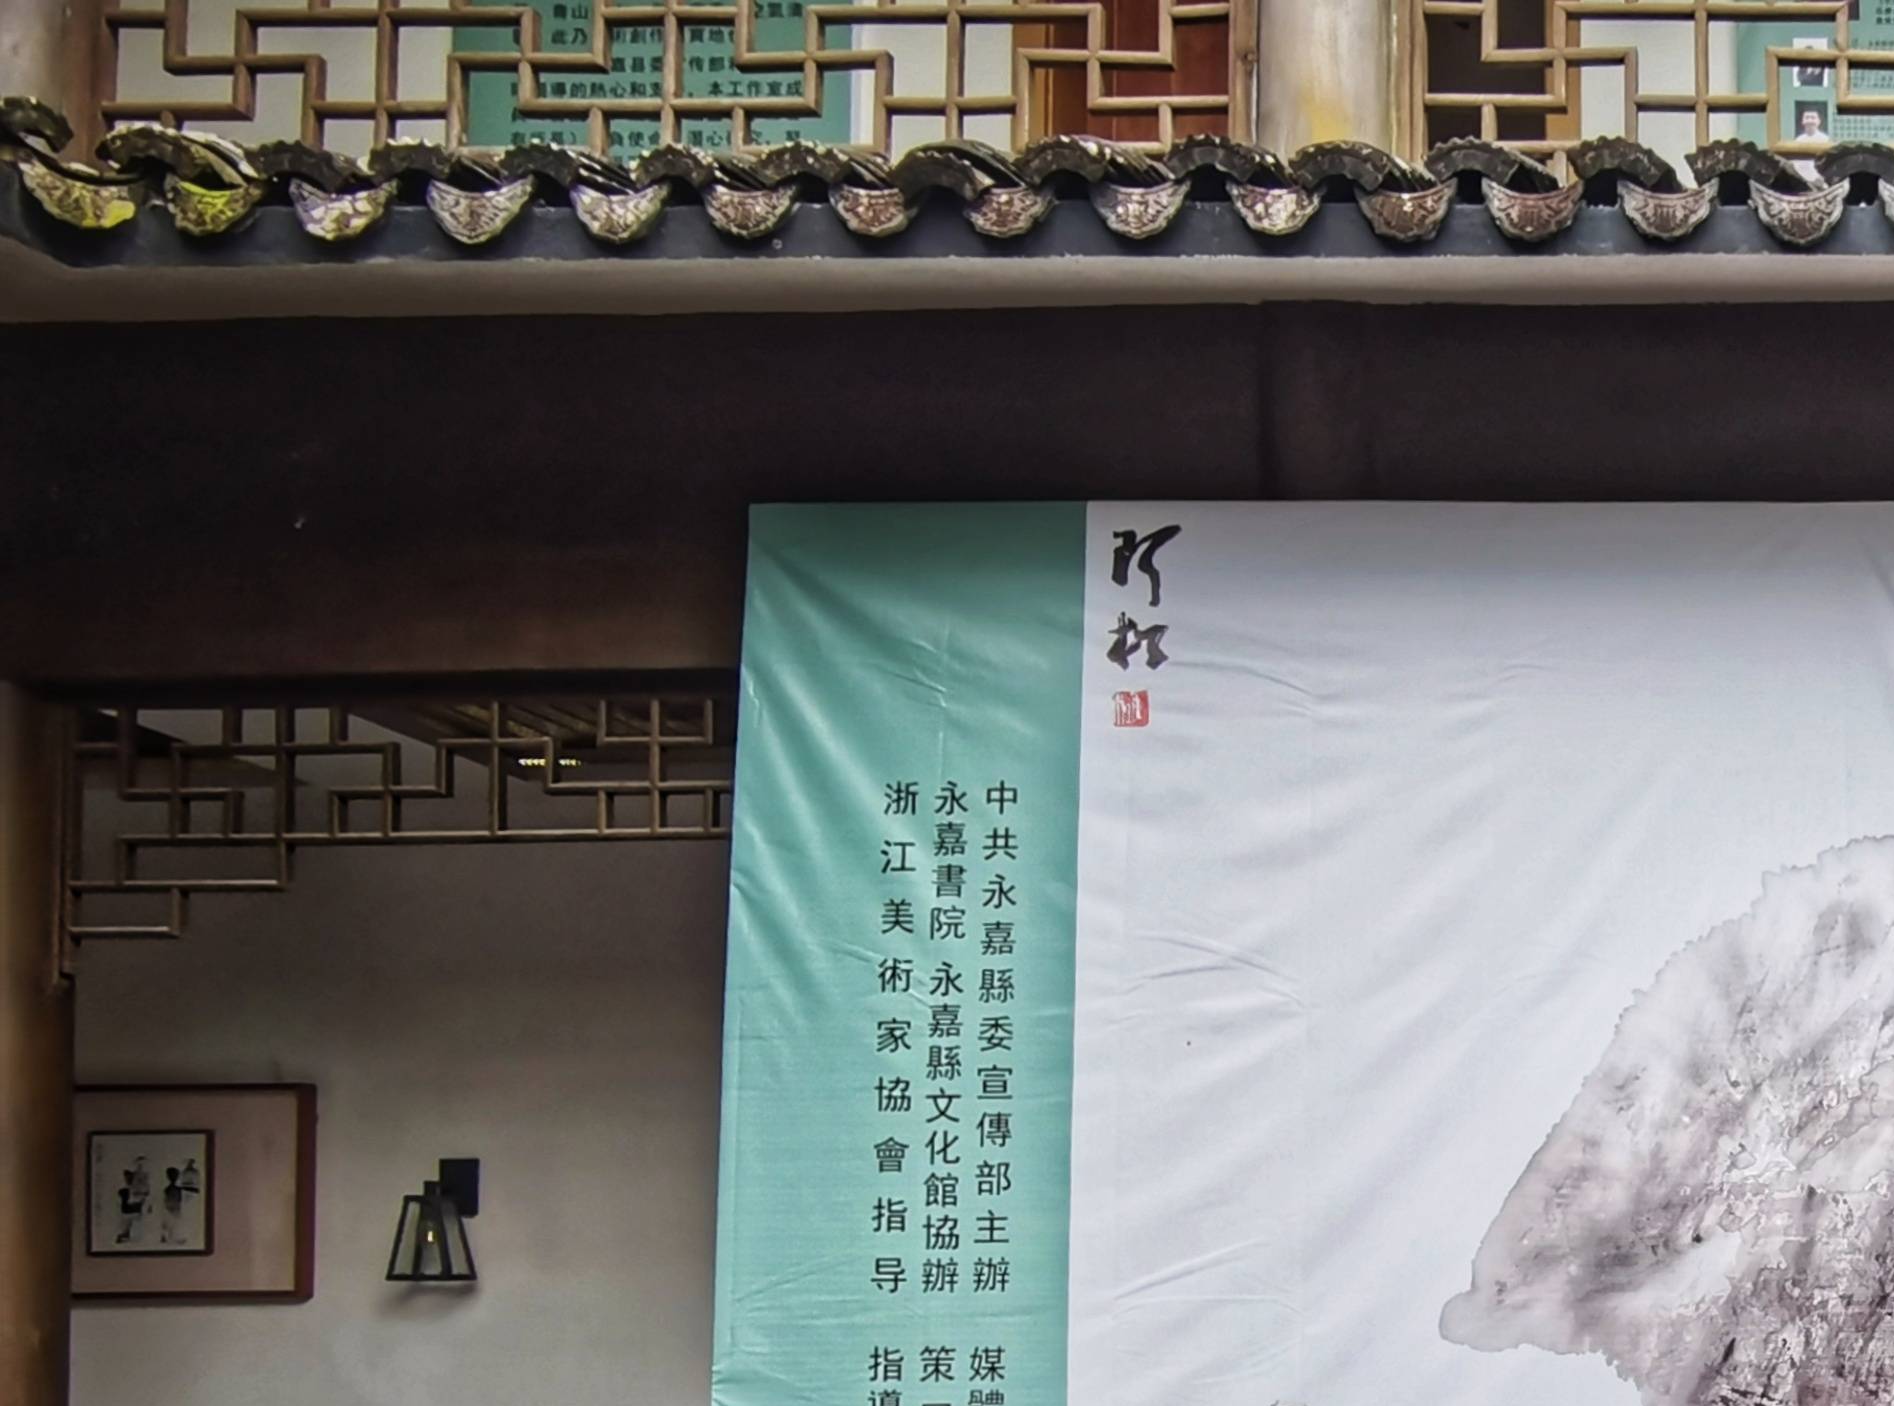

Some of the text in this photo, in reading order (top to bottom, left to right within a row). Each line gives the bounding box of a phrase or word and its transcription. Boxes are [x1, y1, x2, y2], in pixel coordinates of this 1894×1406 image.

[871, 780, 919, 1294] 浙江美術家協會指导
[922, 781, 969, 1294] 永嘉書院 永嘉縣文化館協辦
[973, 780, 1018, 1293] 中共永嘉縣委宣傳部主辦
